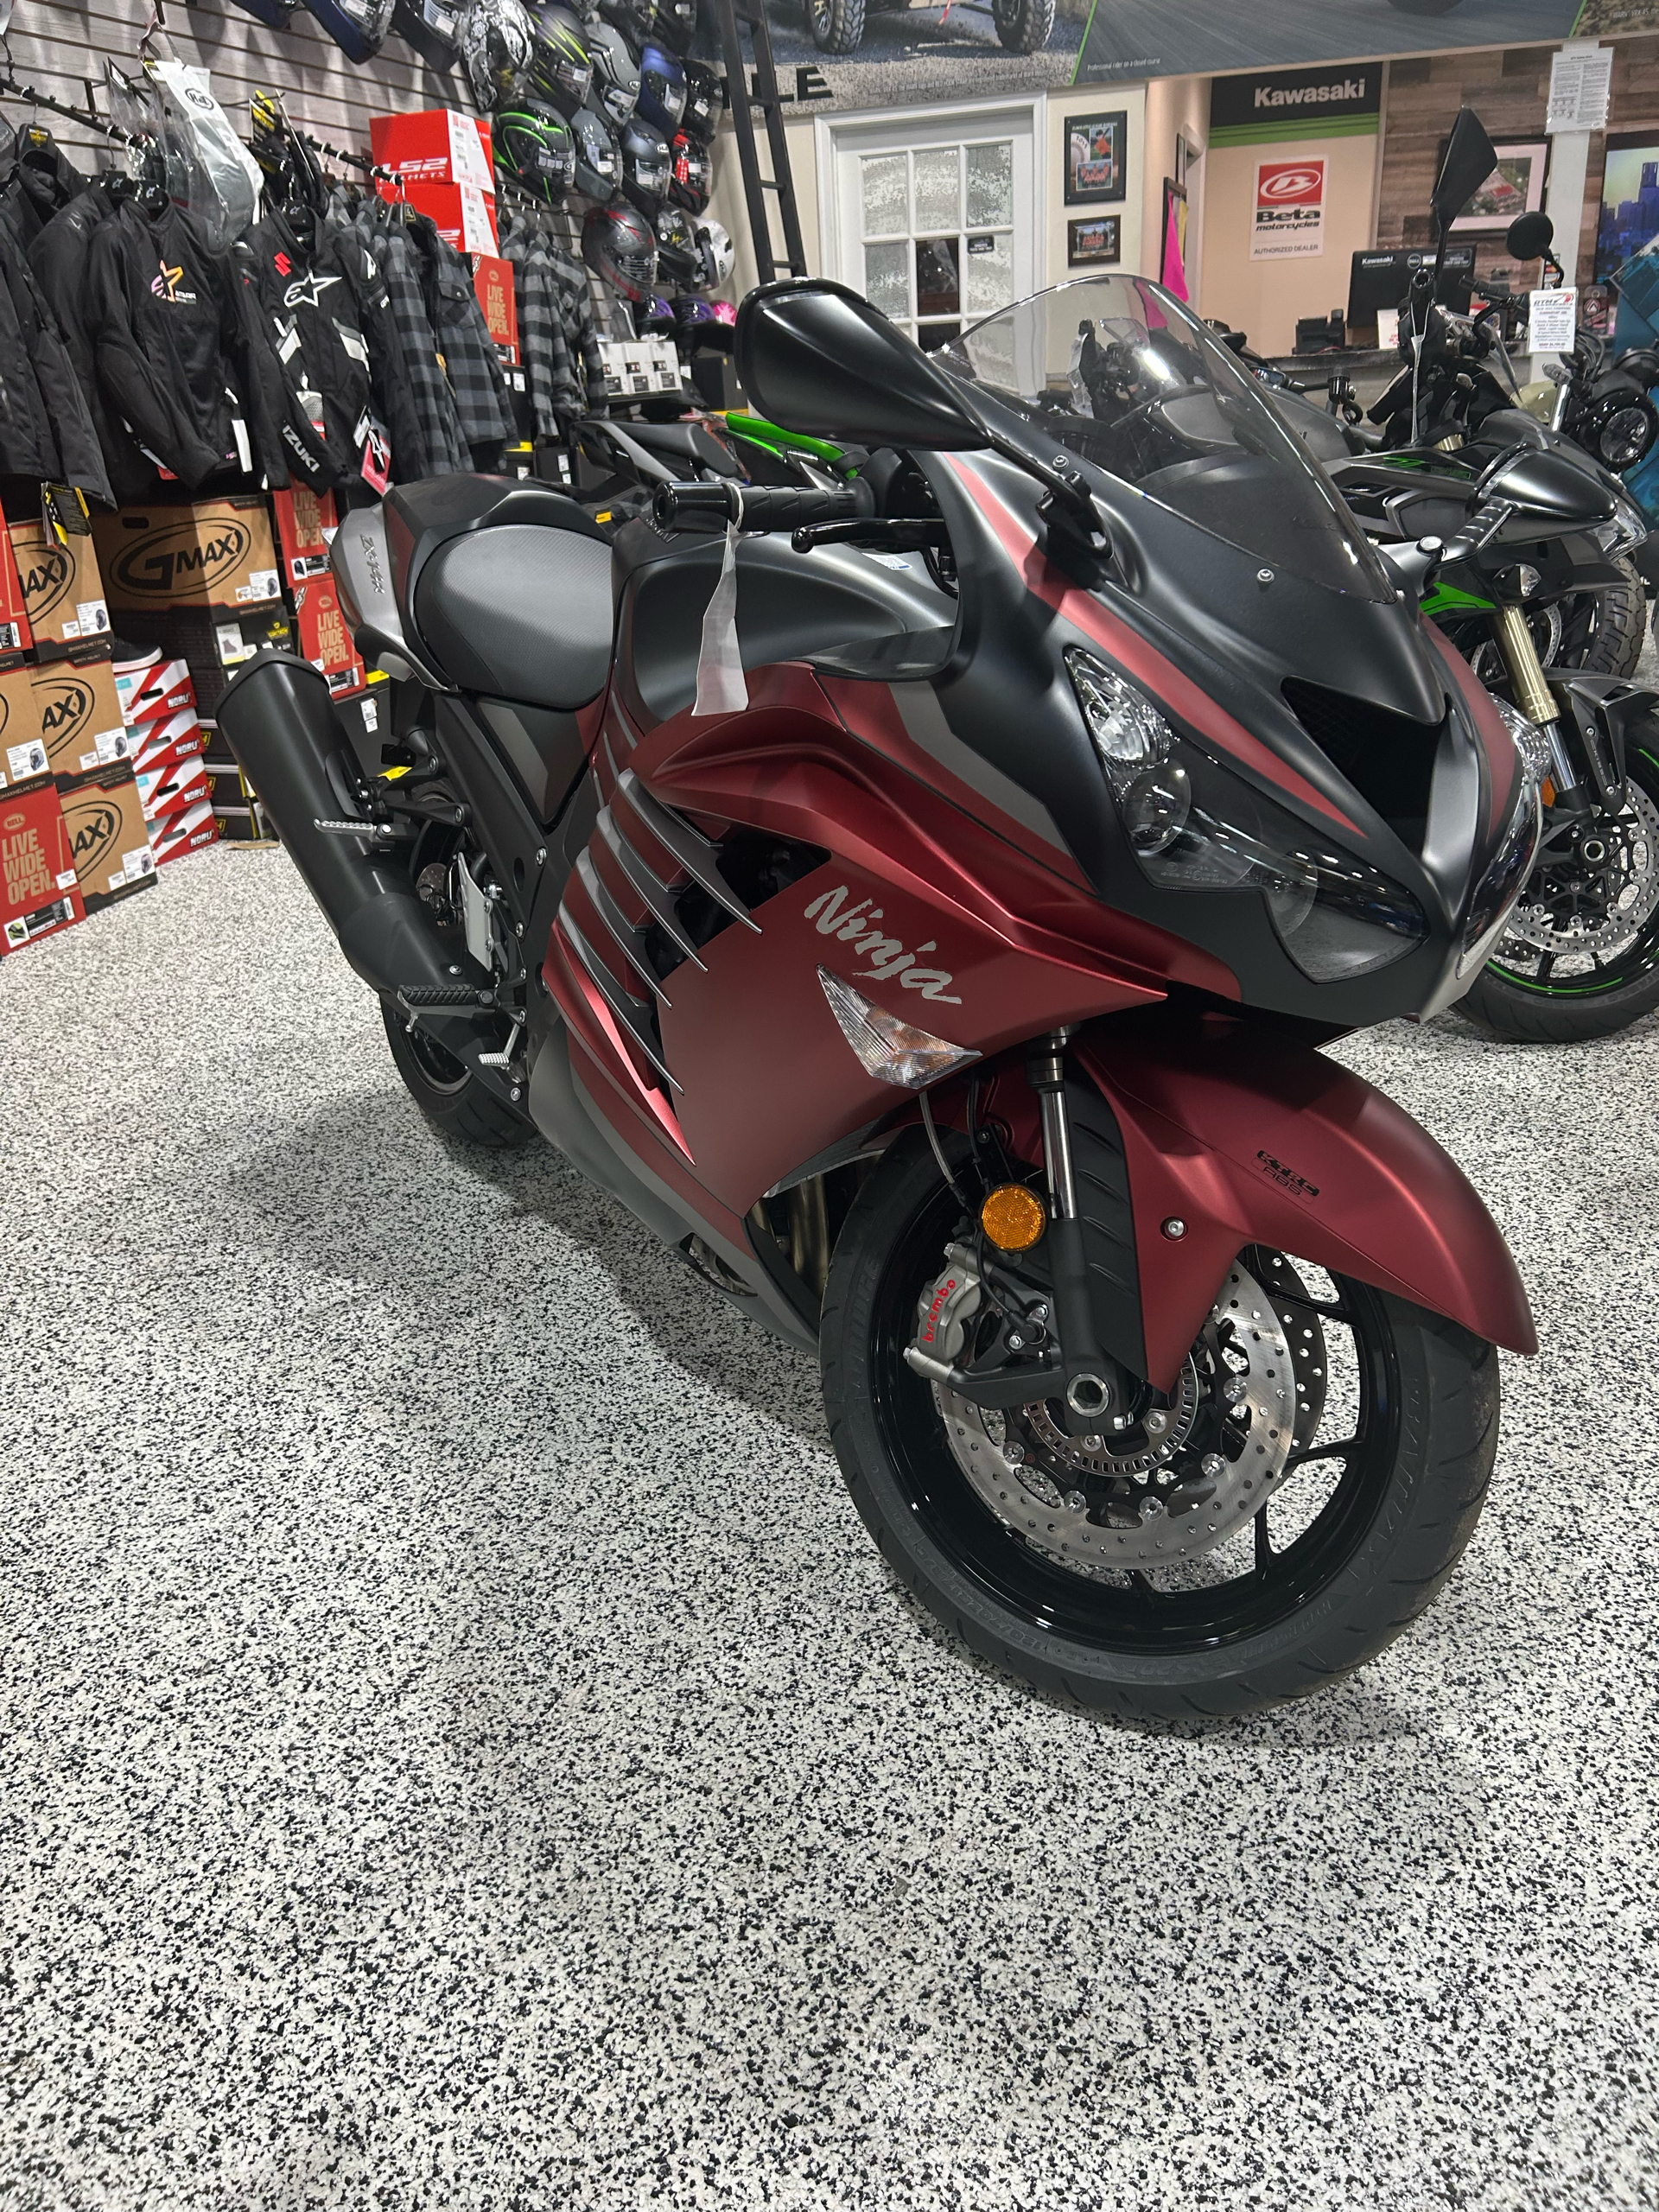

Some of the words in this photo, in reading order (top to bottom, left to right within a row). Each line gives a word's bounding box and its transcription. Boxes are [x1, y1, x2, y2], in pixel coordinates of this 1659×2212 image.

[1254, 78, 1365, 108] Kawasaki
[381, 157, 448, 175] LS2
[1255, 208, 1321, 223] Beta
[1255, 220, 1319, 232] motorcycles
[1254, 245, 1294, 255] AUTHORIZED
[1362, 256, 1394, 265] Kawasaki
[487, 283, 504, 303] LIVE
[283, 424, 321, 473] ZUKI
[293, 490, 317, 510] LIVE
[294, 508, 321, 530] WIDE
[118, 524, 240, 591] GMAX
[316, 609, 340, 631] LIVE
[317, 626, 344, 648] WIDE
[319, 647, 349, 667] OPEN.
[167, 693, 189, 709] NORU
[175, 740, 199, 755] NORU
[183, 785, 206, 802] NORU
[2, 829, 39, 861] LIVE
[69, 815, 109, 859] AX
[190, 830, 213, 848] NORU
[3, 849, 47, 885] WIDE
[8, 868, 56, 906] OPEN.
[804, 885, 963, 1005] Ninja
[1262, 1166, 1303, 1196] ABS
[922, 1279, 957, 1343] brembo
